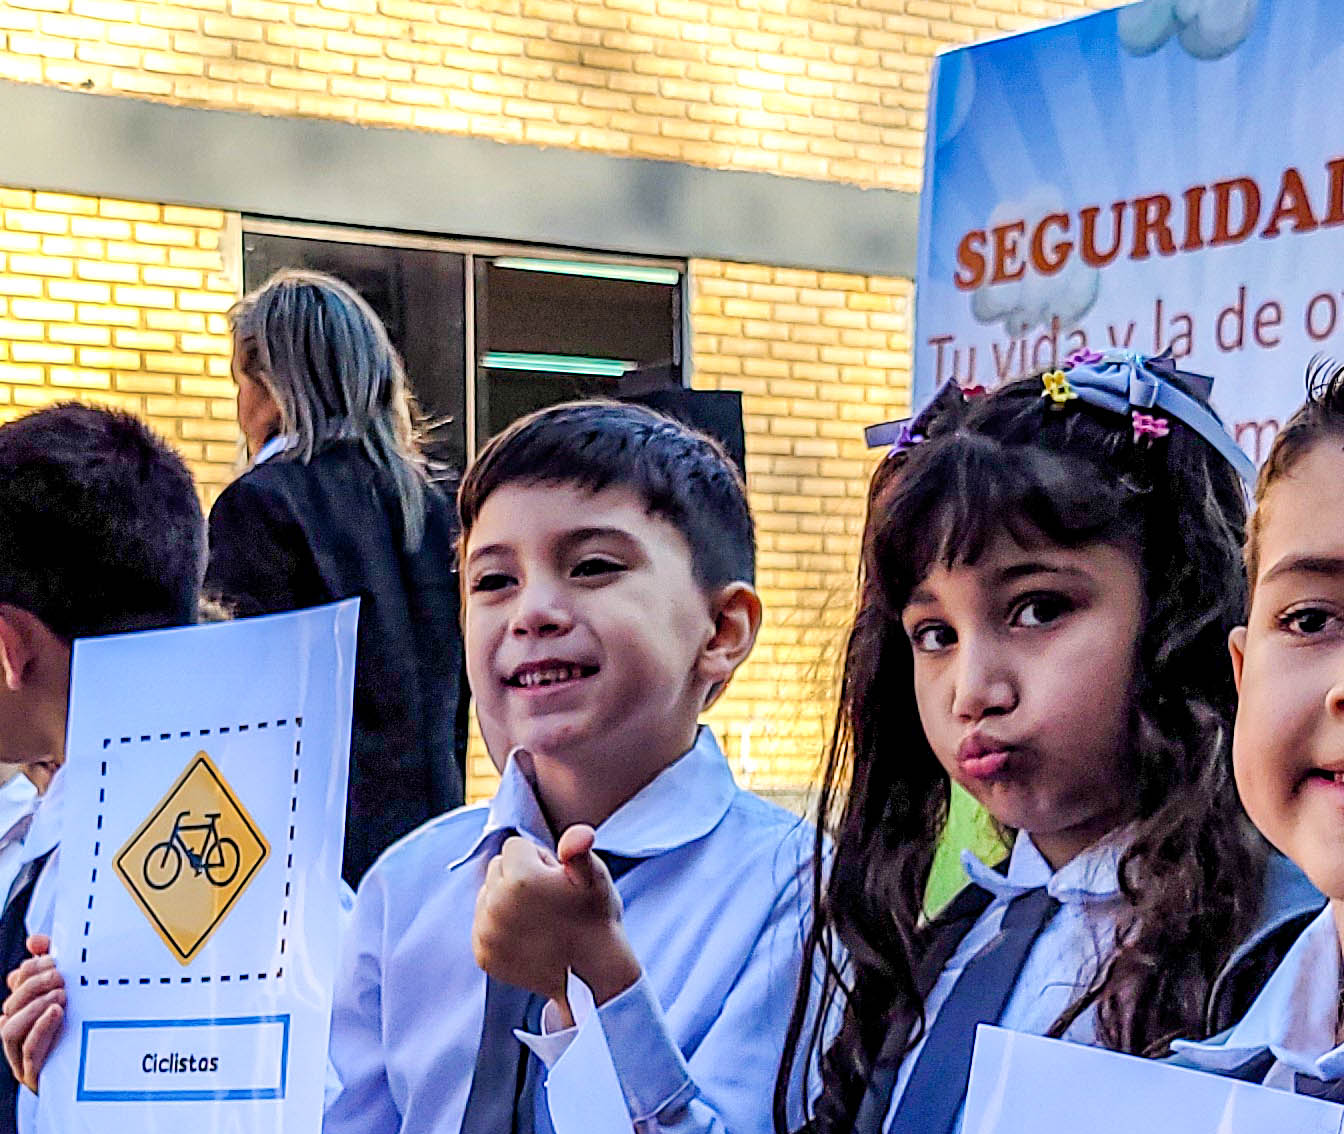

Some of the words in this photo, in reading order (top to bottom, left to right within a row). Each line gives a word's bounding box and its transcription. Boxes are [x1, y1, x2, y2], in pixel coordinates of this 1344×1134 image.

[927, 335, 977, 384] Tu
[992, 315, 1087, 382] vida
[1155, 298, 1194, 359] la
[1215, 285, 1283, 353] de
[141, 1052, 219, 1074] Ciclistas
